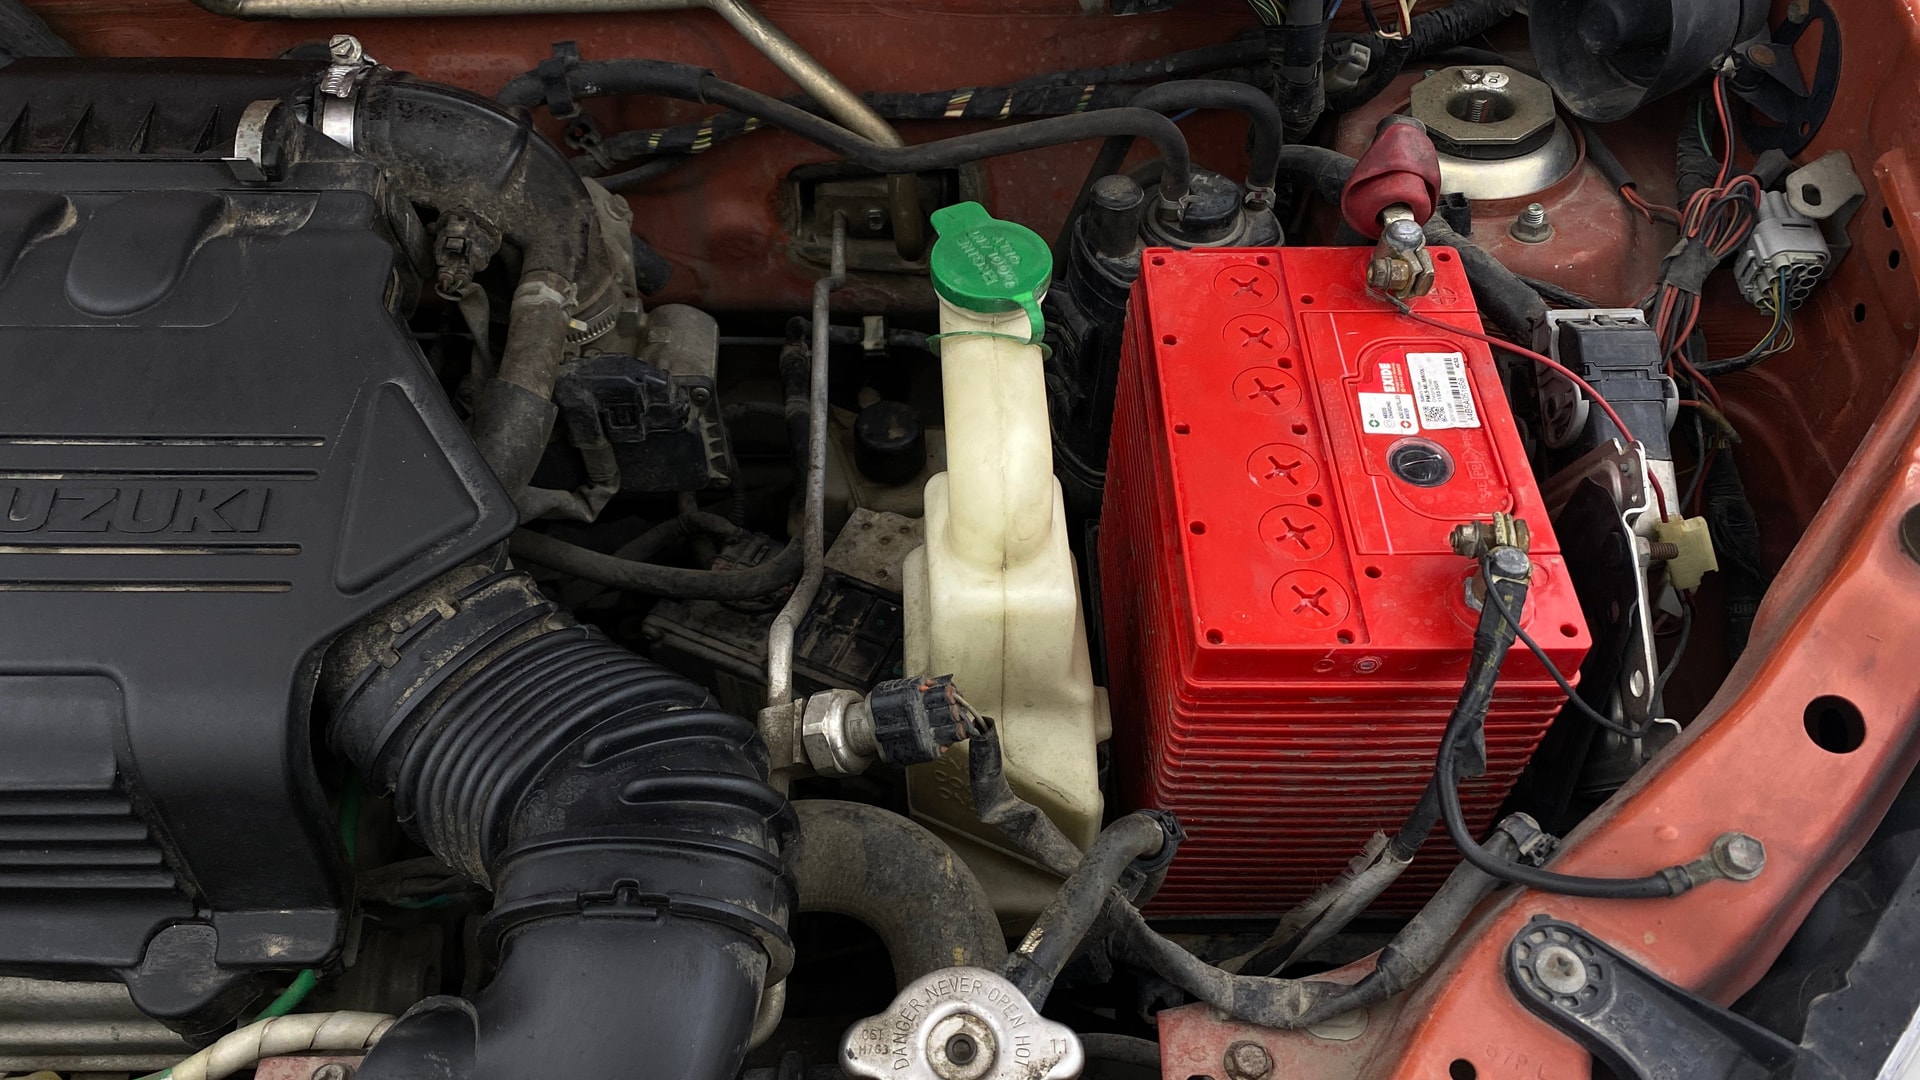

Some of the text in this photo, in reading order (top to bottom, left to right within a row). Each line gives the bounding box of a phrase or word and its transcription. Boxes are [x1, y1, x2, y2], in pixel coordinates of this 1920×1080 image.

[993, 236, 1020, 265] ONLY
[1377, 362, 1396, 393] EXIDE
[893, 976, 1031, 1071] DANGER NEVER OPEN HOT
